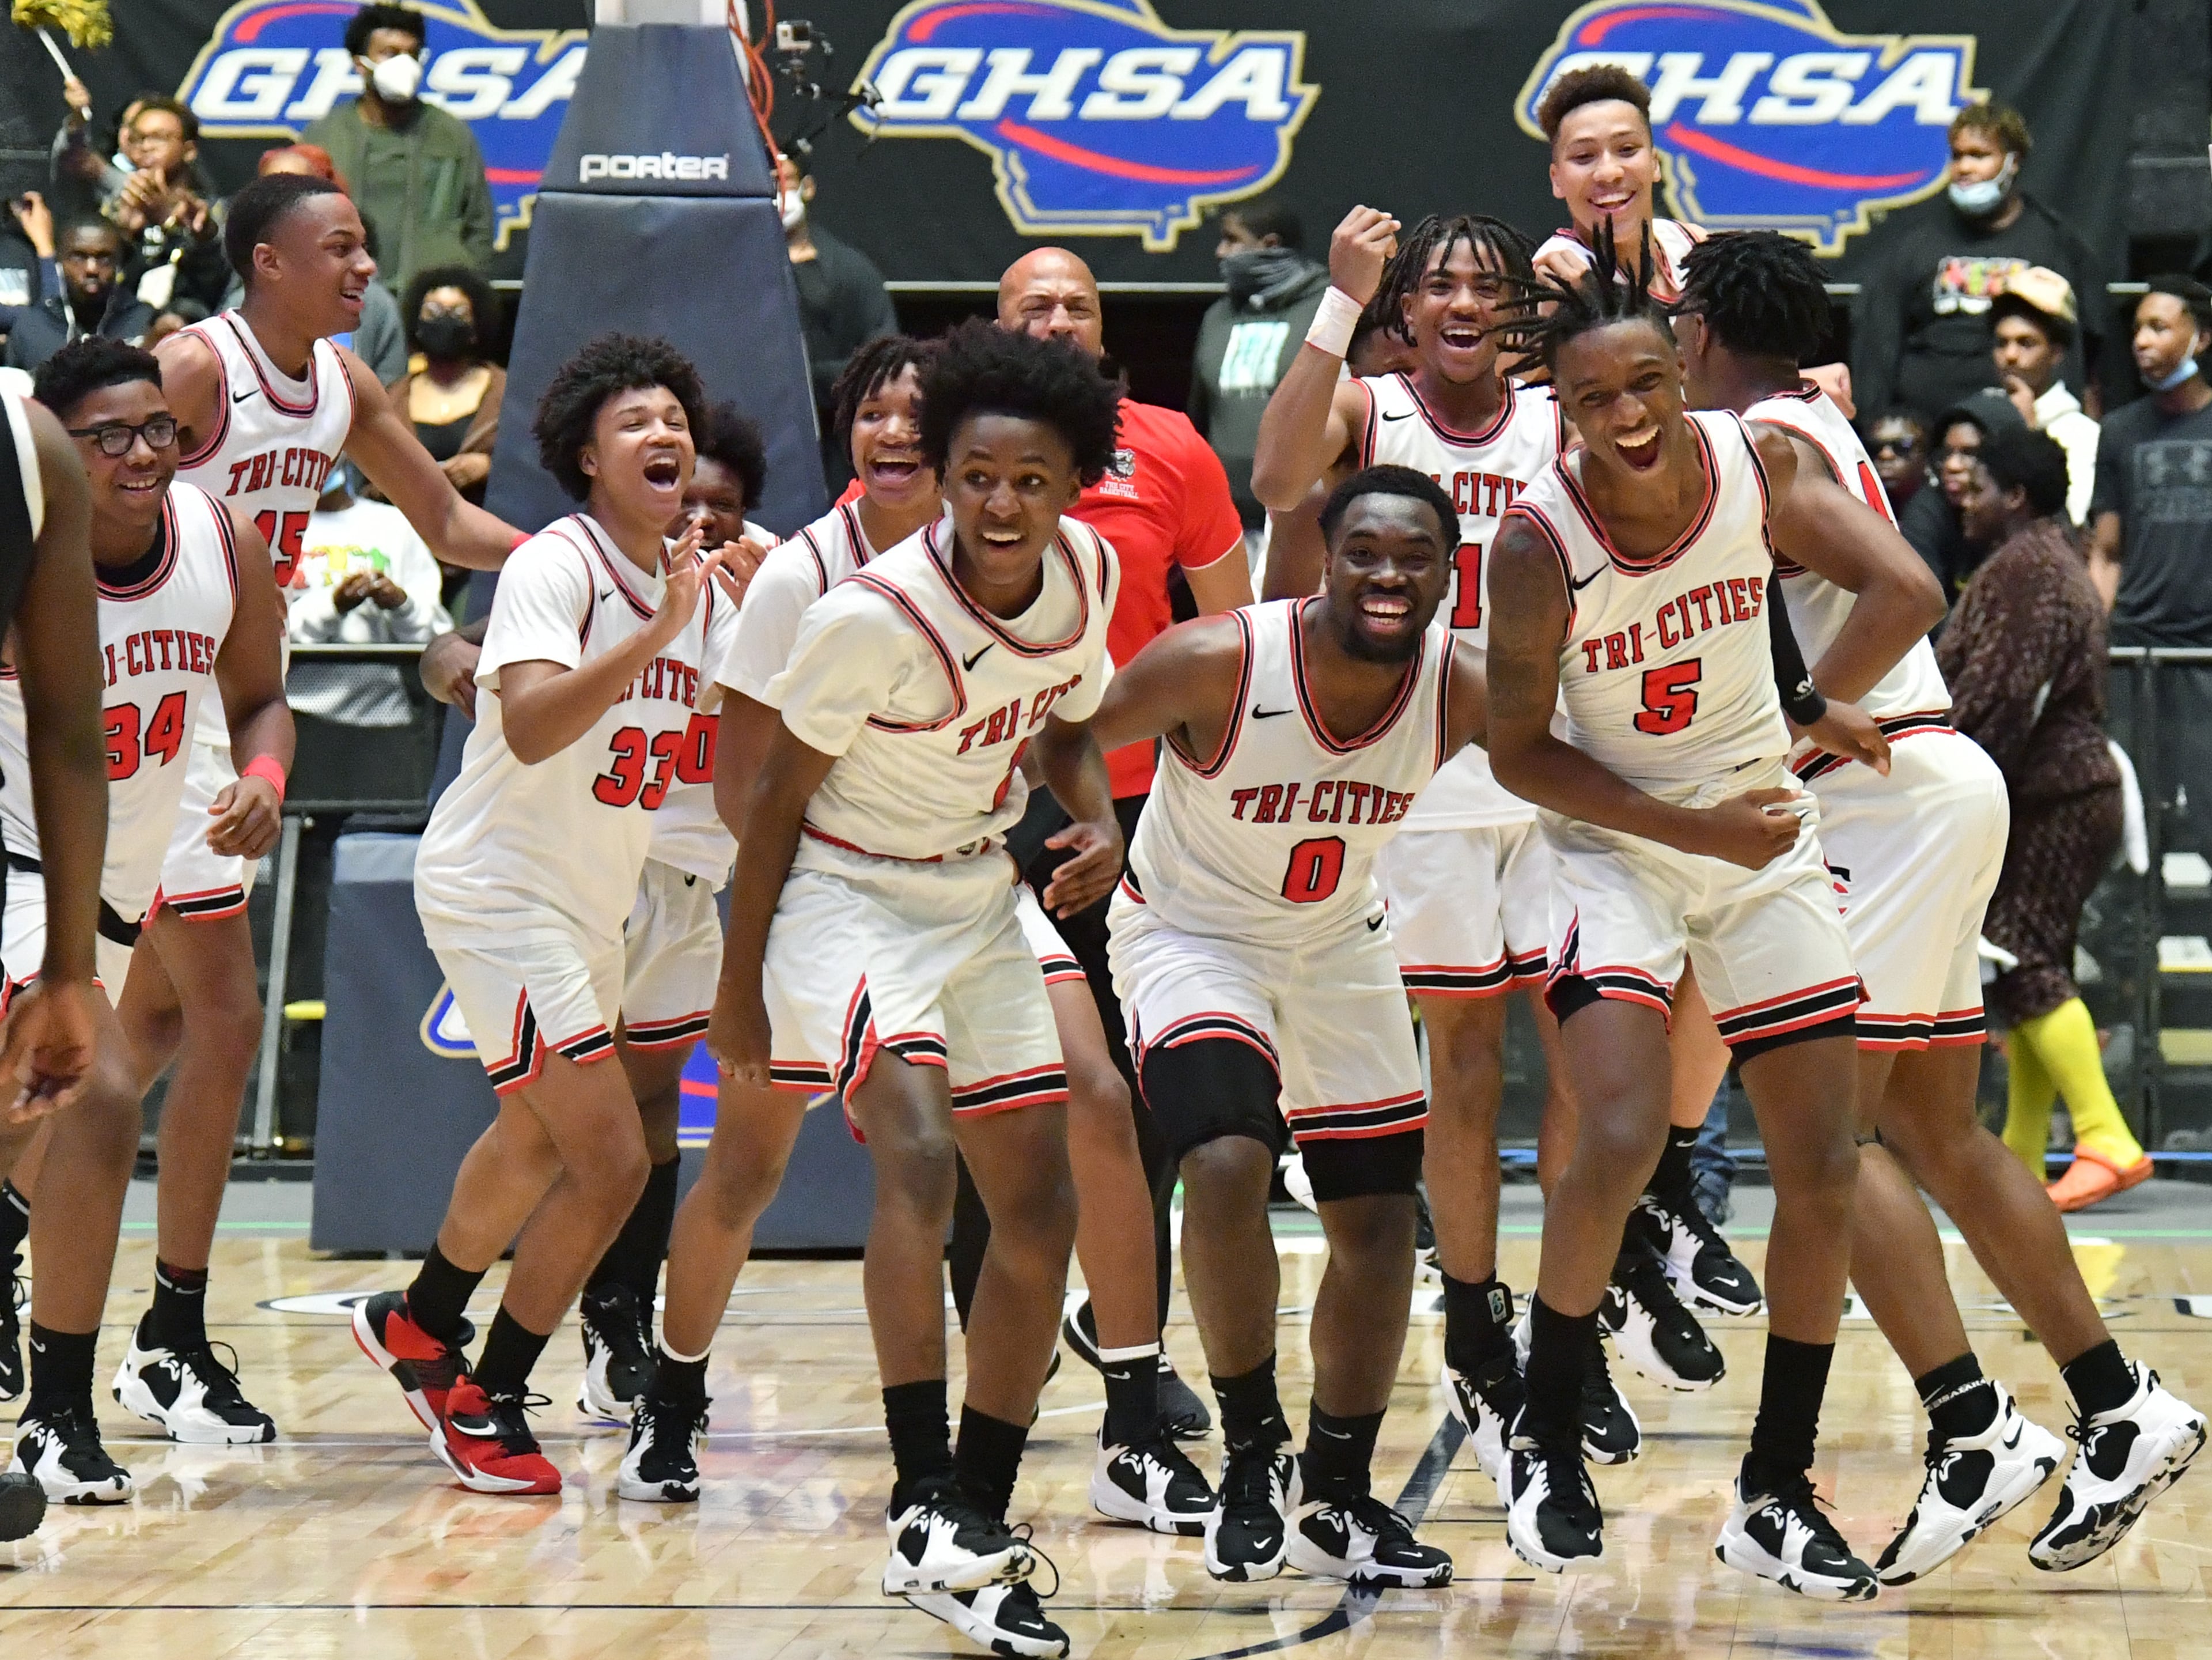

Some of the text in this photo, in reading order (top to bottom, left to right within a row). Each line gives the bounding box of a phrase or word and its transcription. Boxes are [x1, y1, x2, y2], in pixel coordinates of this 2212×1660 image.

[871, 48, 1291, 120] GHSA
[579, 152, 728, 183] porter
[1582, 577, 1763, 672] TRI-CITIES
[100, 629, 215, 691] I-CITIES
[1634, 657, 1702, 735] 5
[103, 690, 187, 782] 34
[1230, 781, 1415, 825] TRI-CITIES
[1282, 835, 1346, 903] 0
